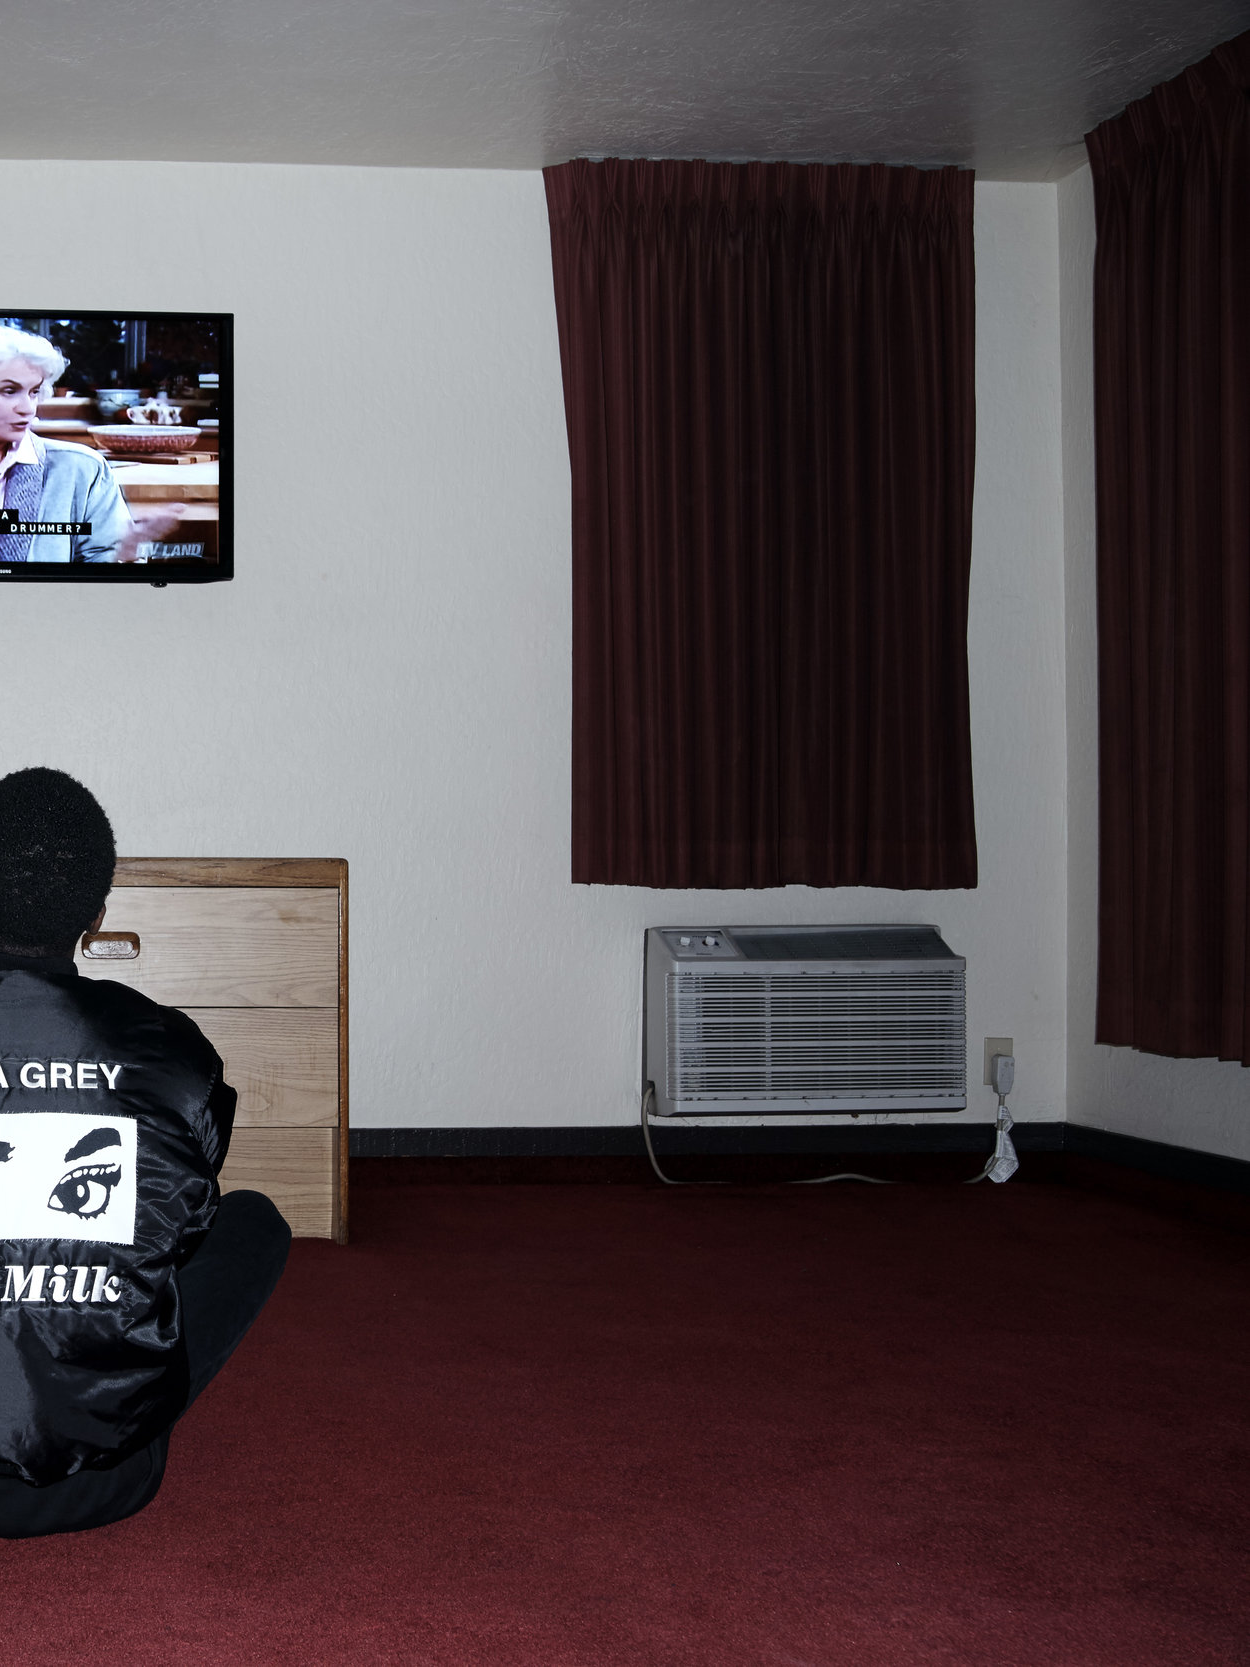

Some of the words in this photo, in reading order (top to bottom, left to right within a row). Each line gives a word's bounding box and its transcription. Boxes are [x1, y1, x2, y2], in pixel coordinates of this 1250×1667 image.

[1, 511, 9, 520] A
[10, 523, 82, 533] DRUMMER?
[138, 542, 160, 557] TV
[162, 543, 202, 557] LAND
[19, 1061, 122, 1090] GREY
[0, 1264, 122, 1303] Milk
